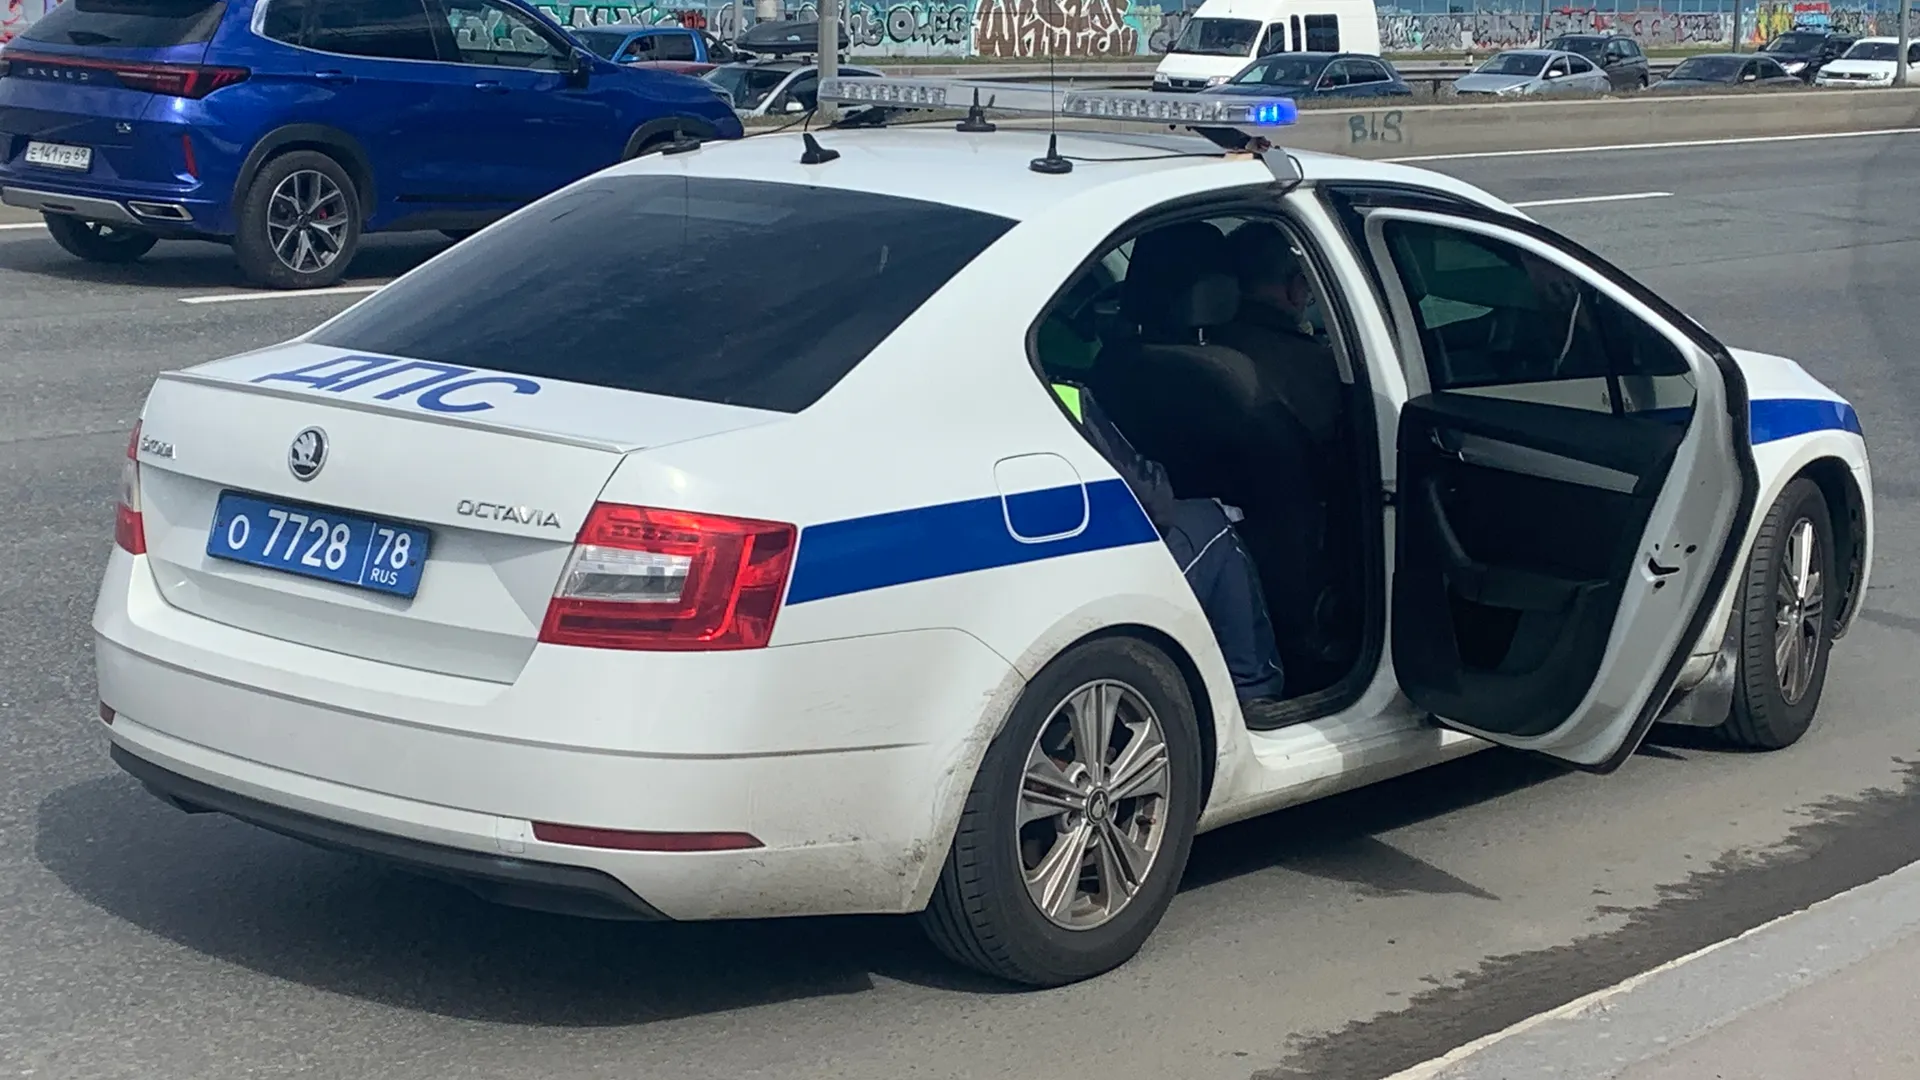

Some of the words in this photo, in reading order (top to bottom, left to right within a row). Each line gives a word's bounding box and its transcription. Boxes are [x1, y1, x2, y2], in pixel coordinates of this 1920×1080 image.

[250, 355, 541, 413] ДПС
[457, 499, 561, 529] OCTAVIA
[262, 509, 351, 571] 7728
[373, 528, 412, 570] 78
[370, 567, 399, 586] RUS
